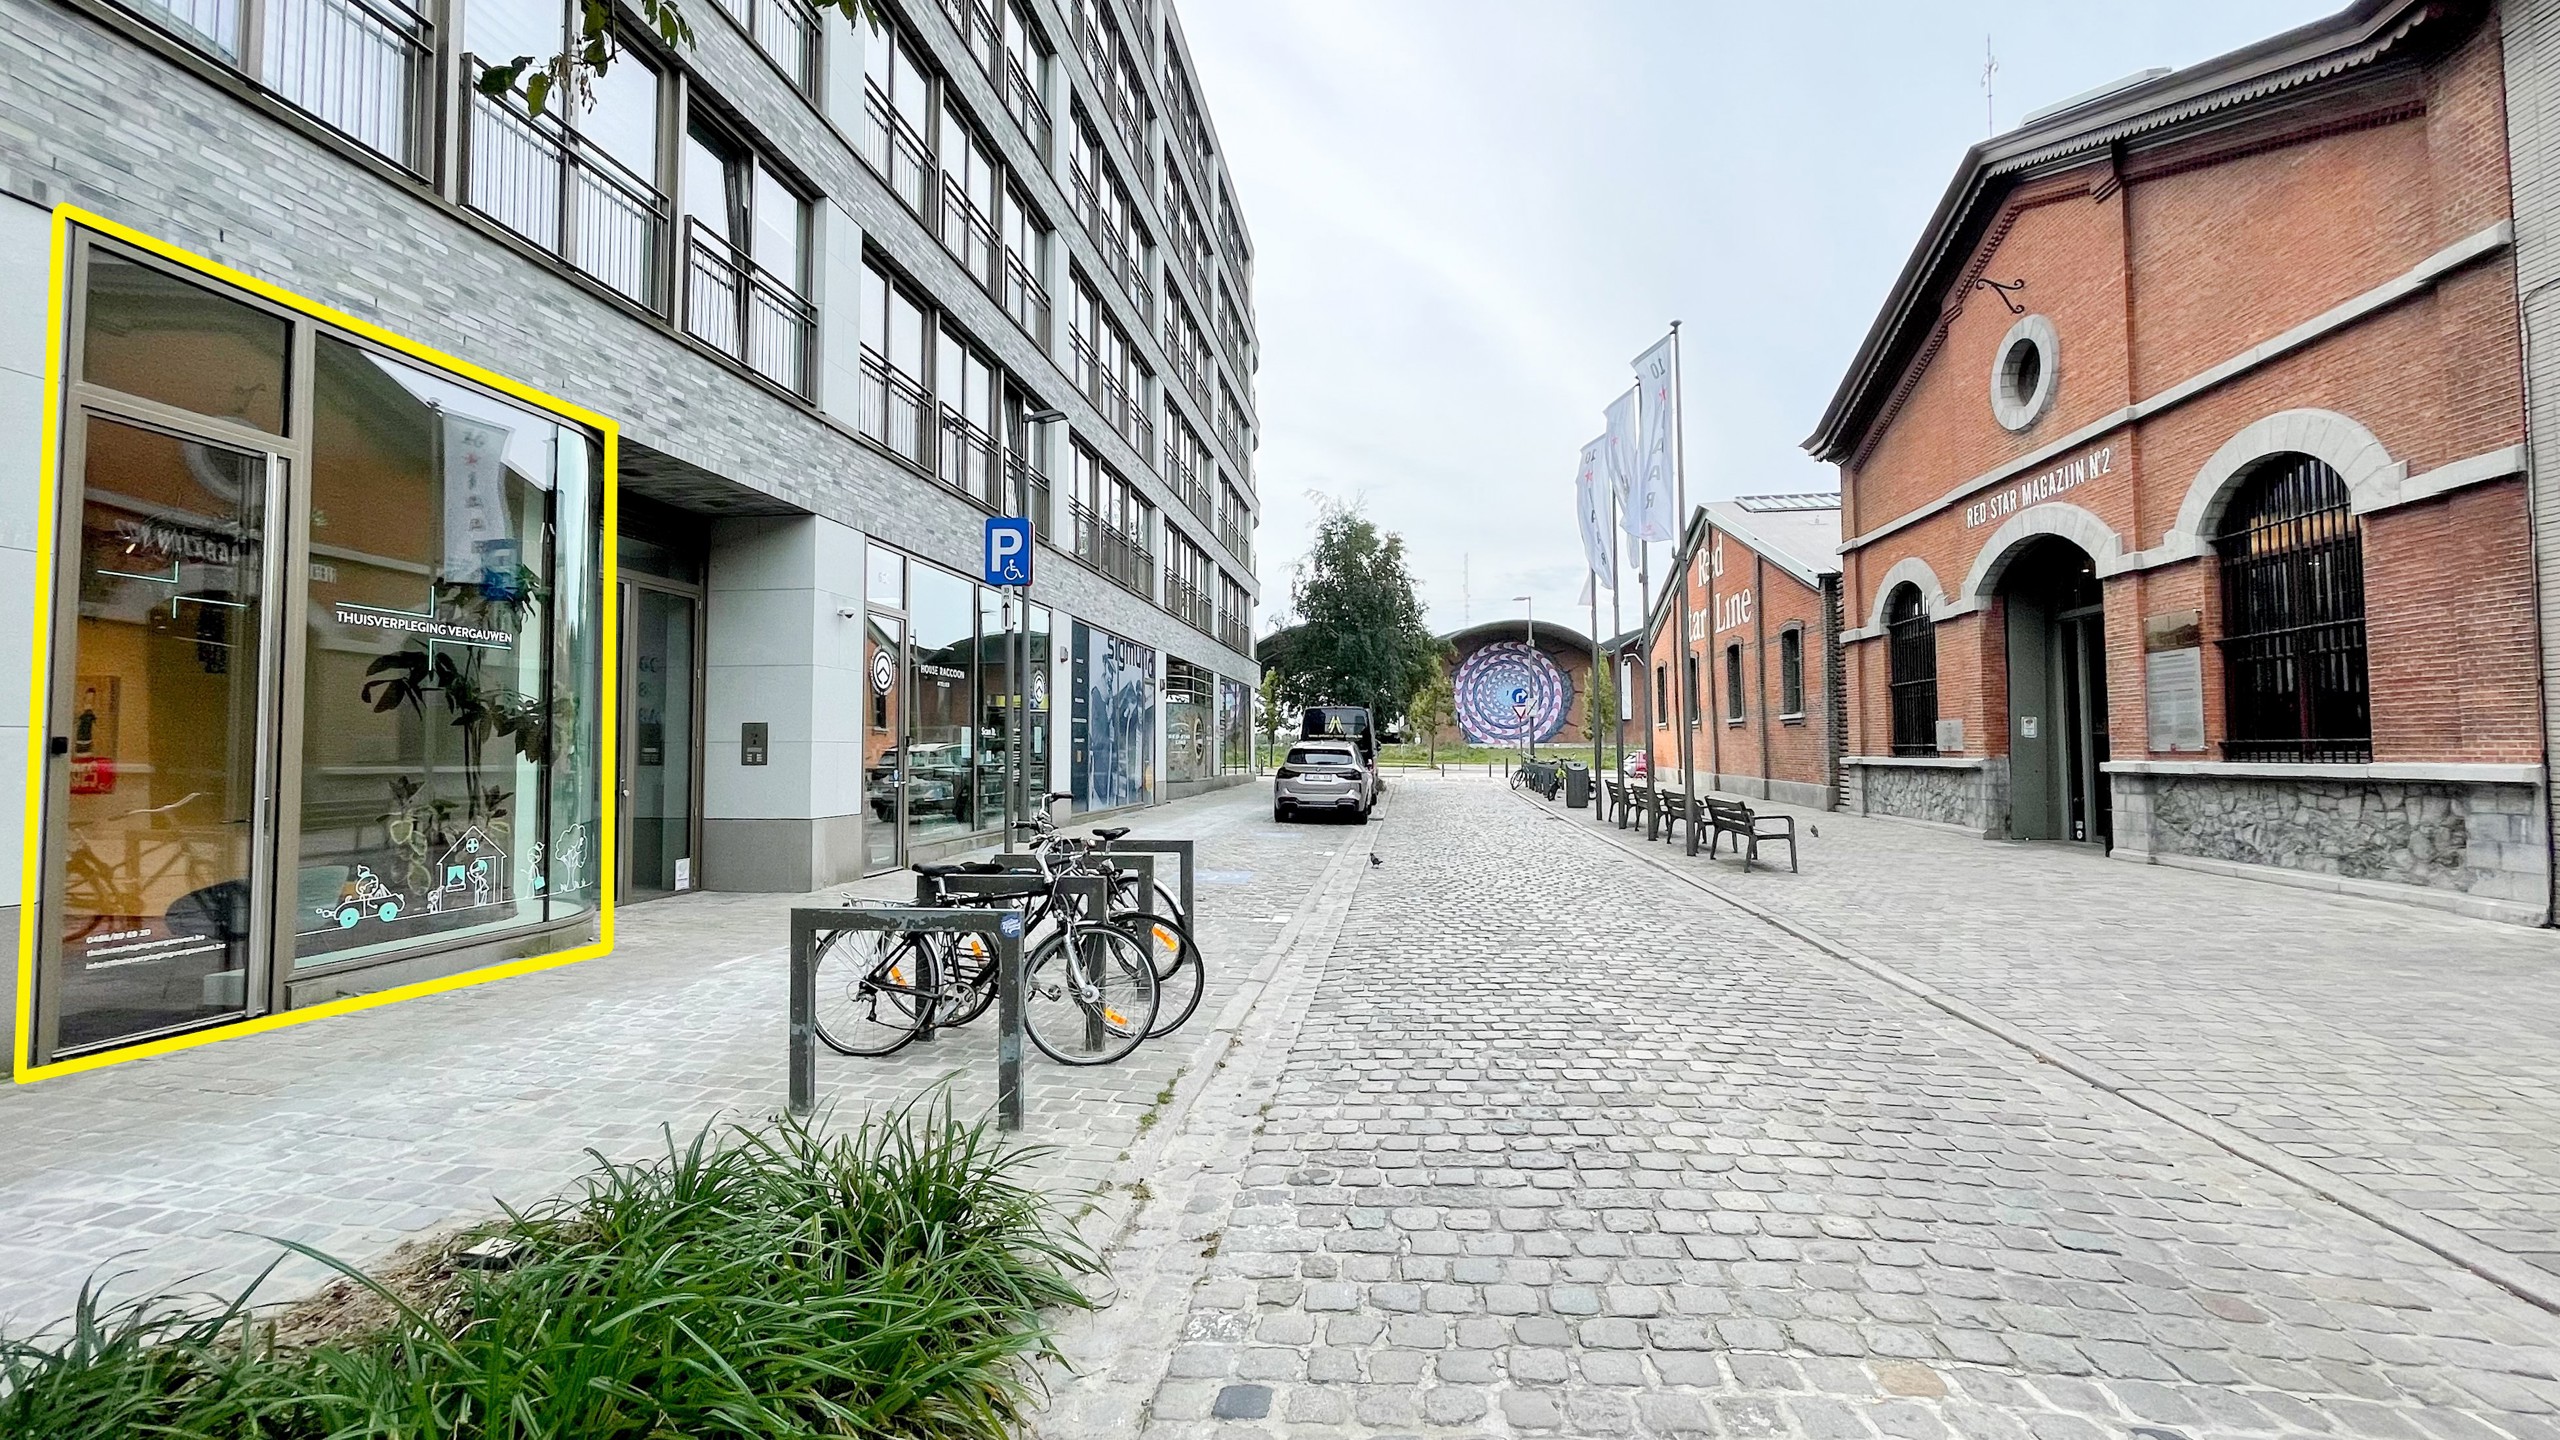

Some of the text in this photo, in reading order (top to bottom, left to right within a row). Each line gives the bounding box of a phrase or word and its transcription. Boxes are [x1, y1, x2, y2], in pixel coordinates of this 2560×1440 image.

[1967, 502, 1986, 529] RED
[1991, 489, 2017, 519] STAR
[2022, 458, 2085, 507] MAGAZIJN
[992, 528, 1023, 572] P
[1697, 532, 1724, 588] Red
[335, 610, 513, 643] THUISVERPLEGING VERGAUWEN
[1688, 588, 1752, 643] tar Line
[920, 664, 965, 680] HOUSE RACCOON
[1107, 634, 1156, 679] sigmund
